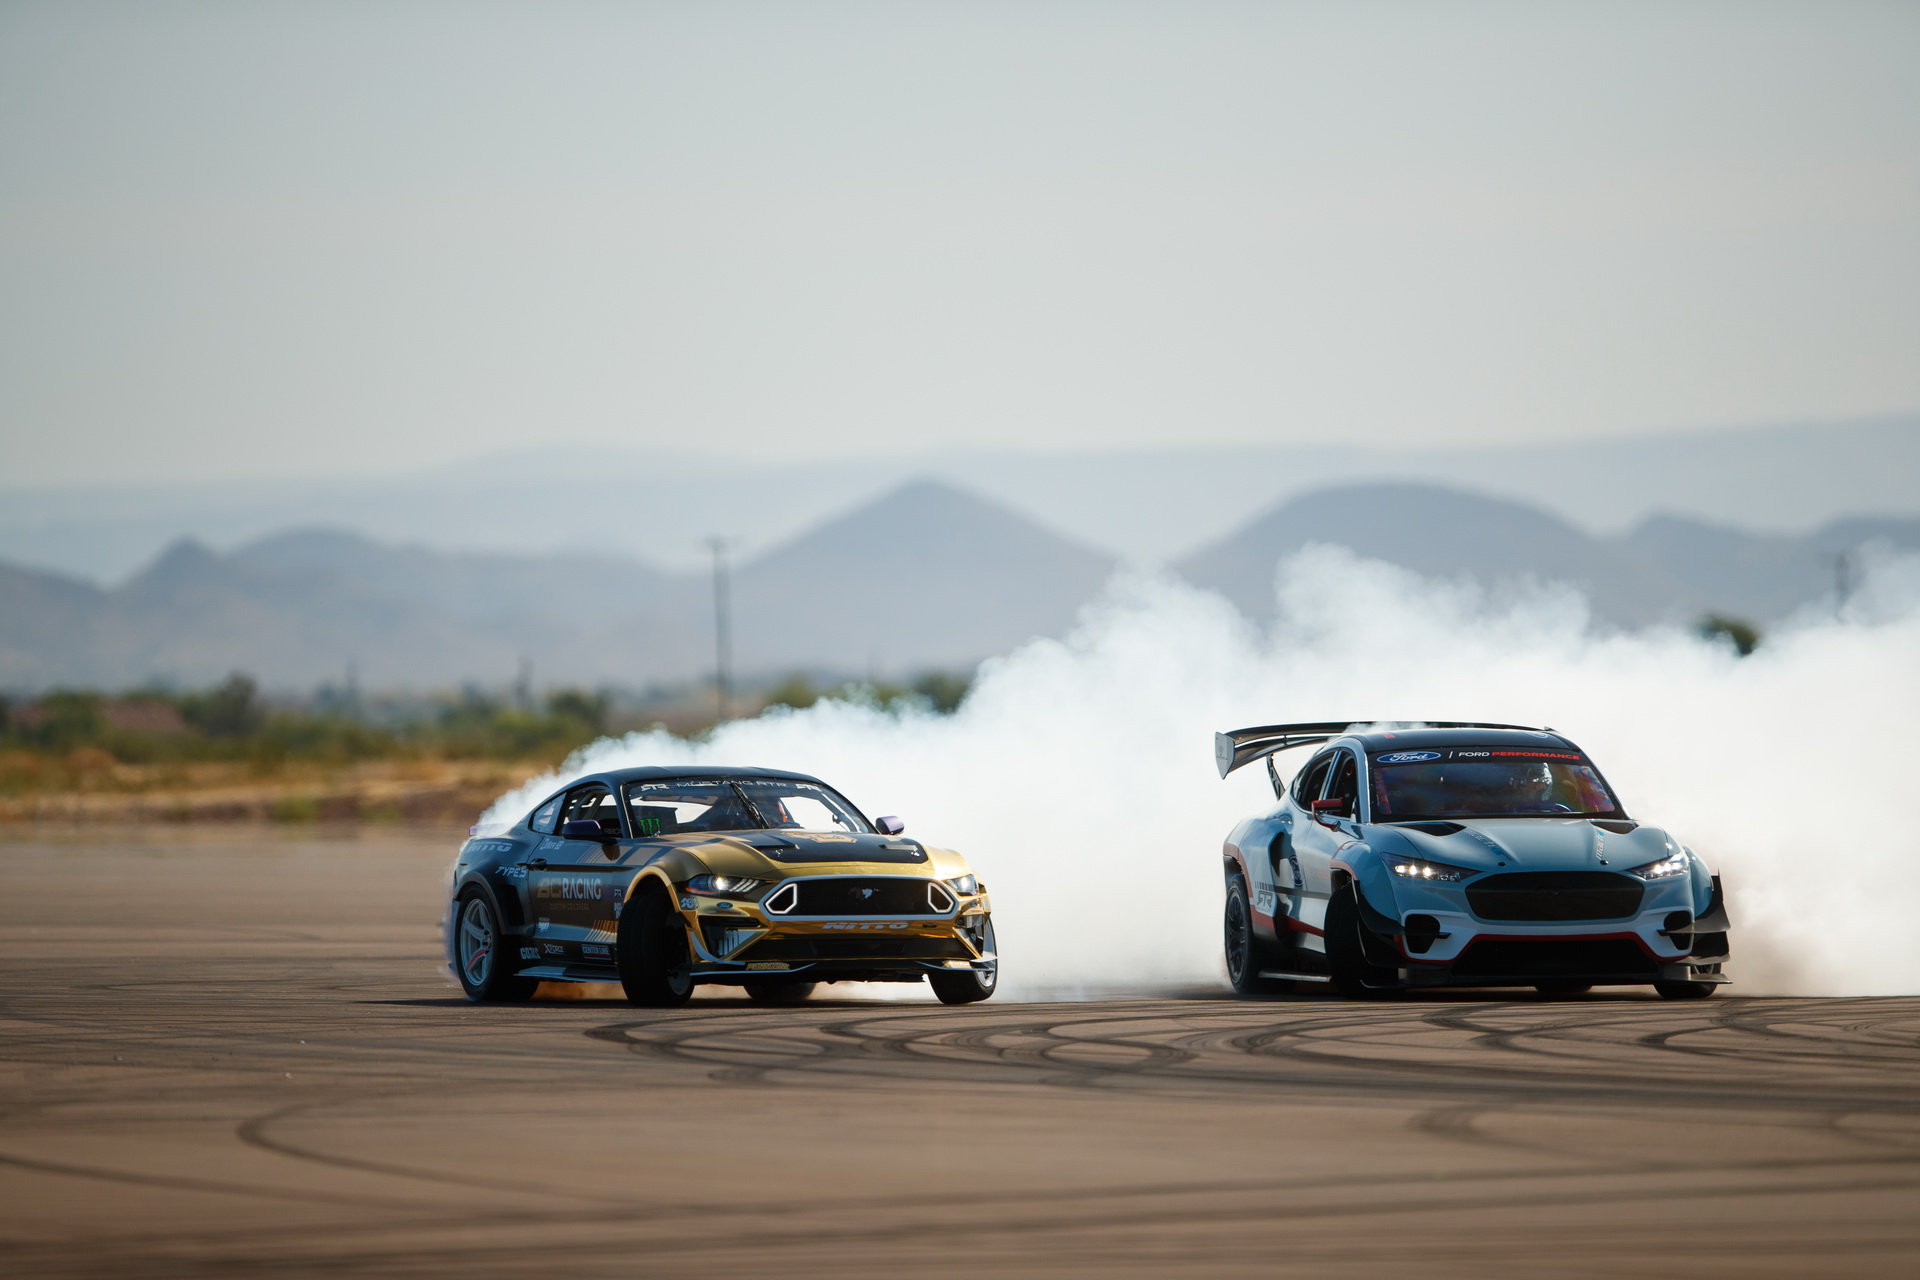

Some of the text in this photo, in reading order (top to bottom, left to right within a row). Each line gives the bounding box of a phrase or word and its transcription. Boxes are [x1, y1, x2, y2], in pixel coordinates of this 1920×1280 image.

[1388, 751, 1430, 762] Ford
[1491, 751, 1580, 760] PERFORMANCE
[676, 780, 751, 788] MUSTANG
[562, 877, 602, 900] RACING
[822, 922, 909, 930] NITTO
